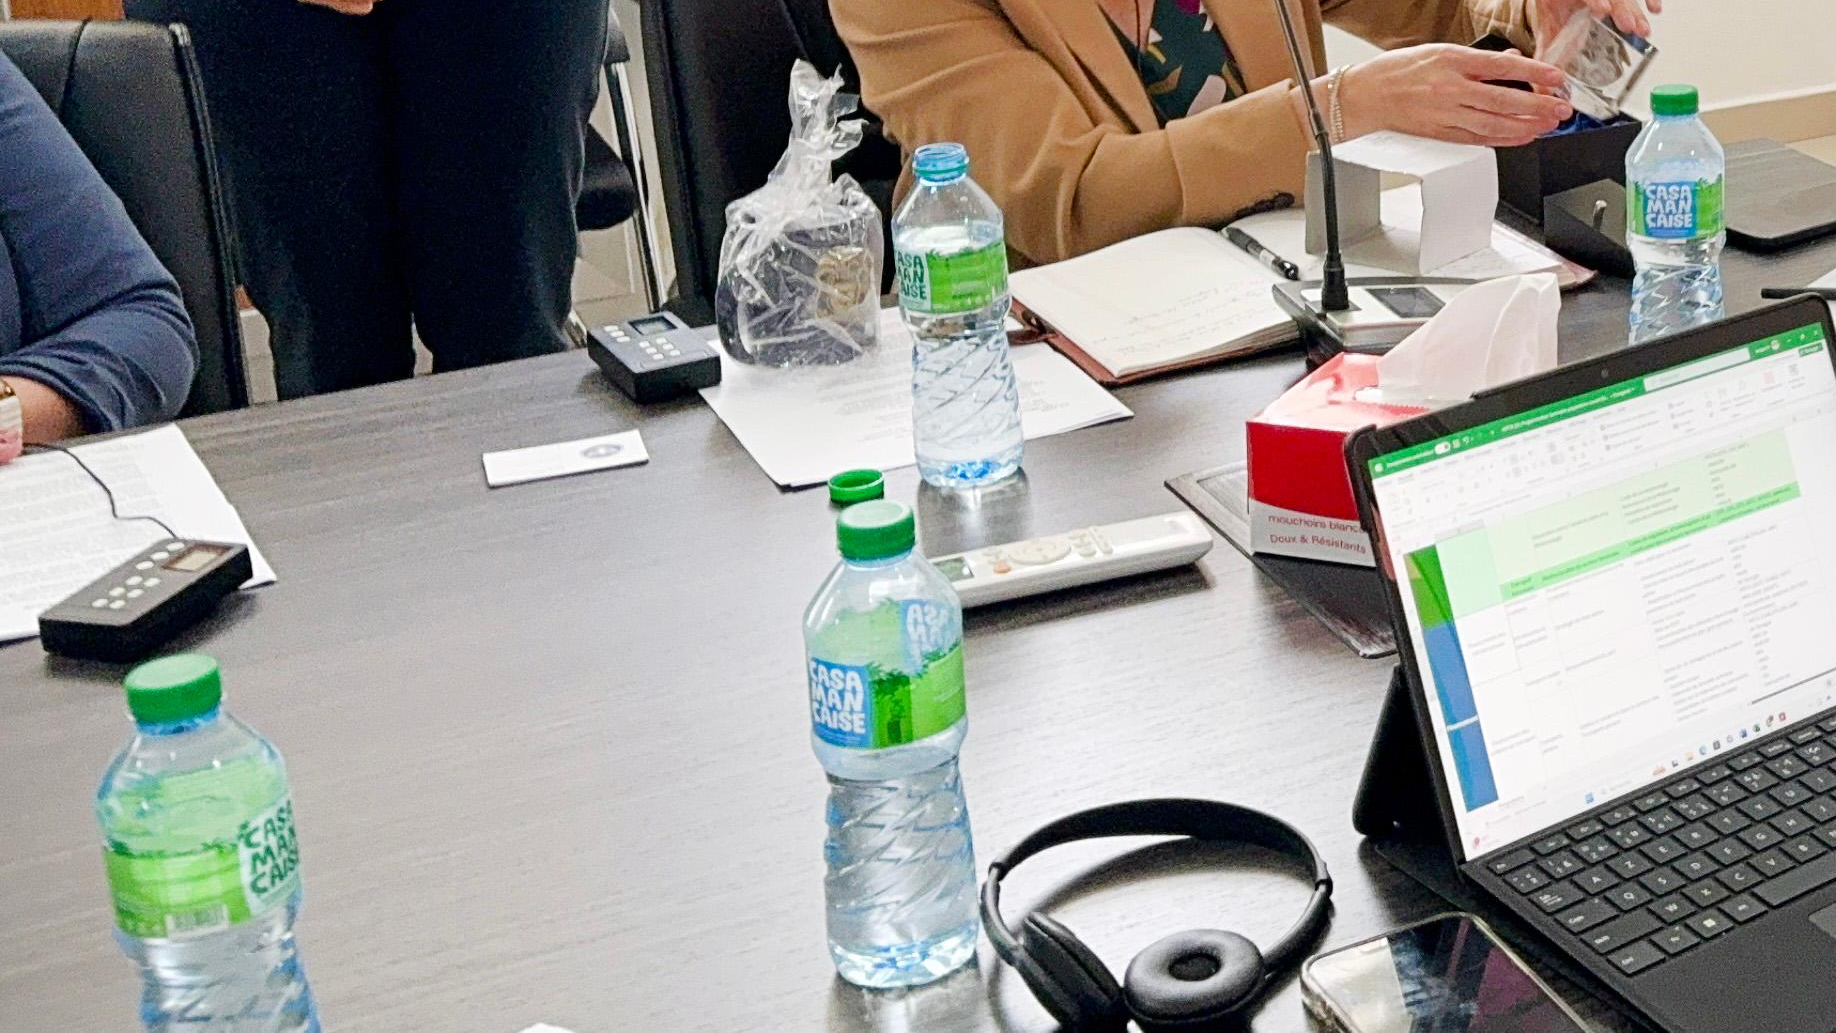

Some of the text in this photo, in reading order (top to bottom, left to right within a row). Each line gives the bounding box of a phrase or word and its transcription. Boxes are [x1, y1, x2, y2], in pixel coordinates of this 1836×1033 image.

[1645, 185, 1692, 201] CASA
[1647, 198, 1692, 214] MAN
[897, 251, 924, 269] ASA
[900, 281, 928, 300] AISE
[1268, 515, 1361, 534] mouchoirs blanc
[1270, 534, 1367, 555] Doux & Résistants
[809, 661, 864, 693] CASA
[811, 681, 864, 713] MAN
[250, 850, 299, 895] CAIS
